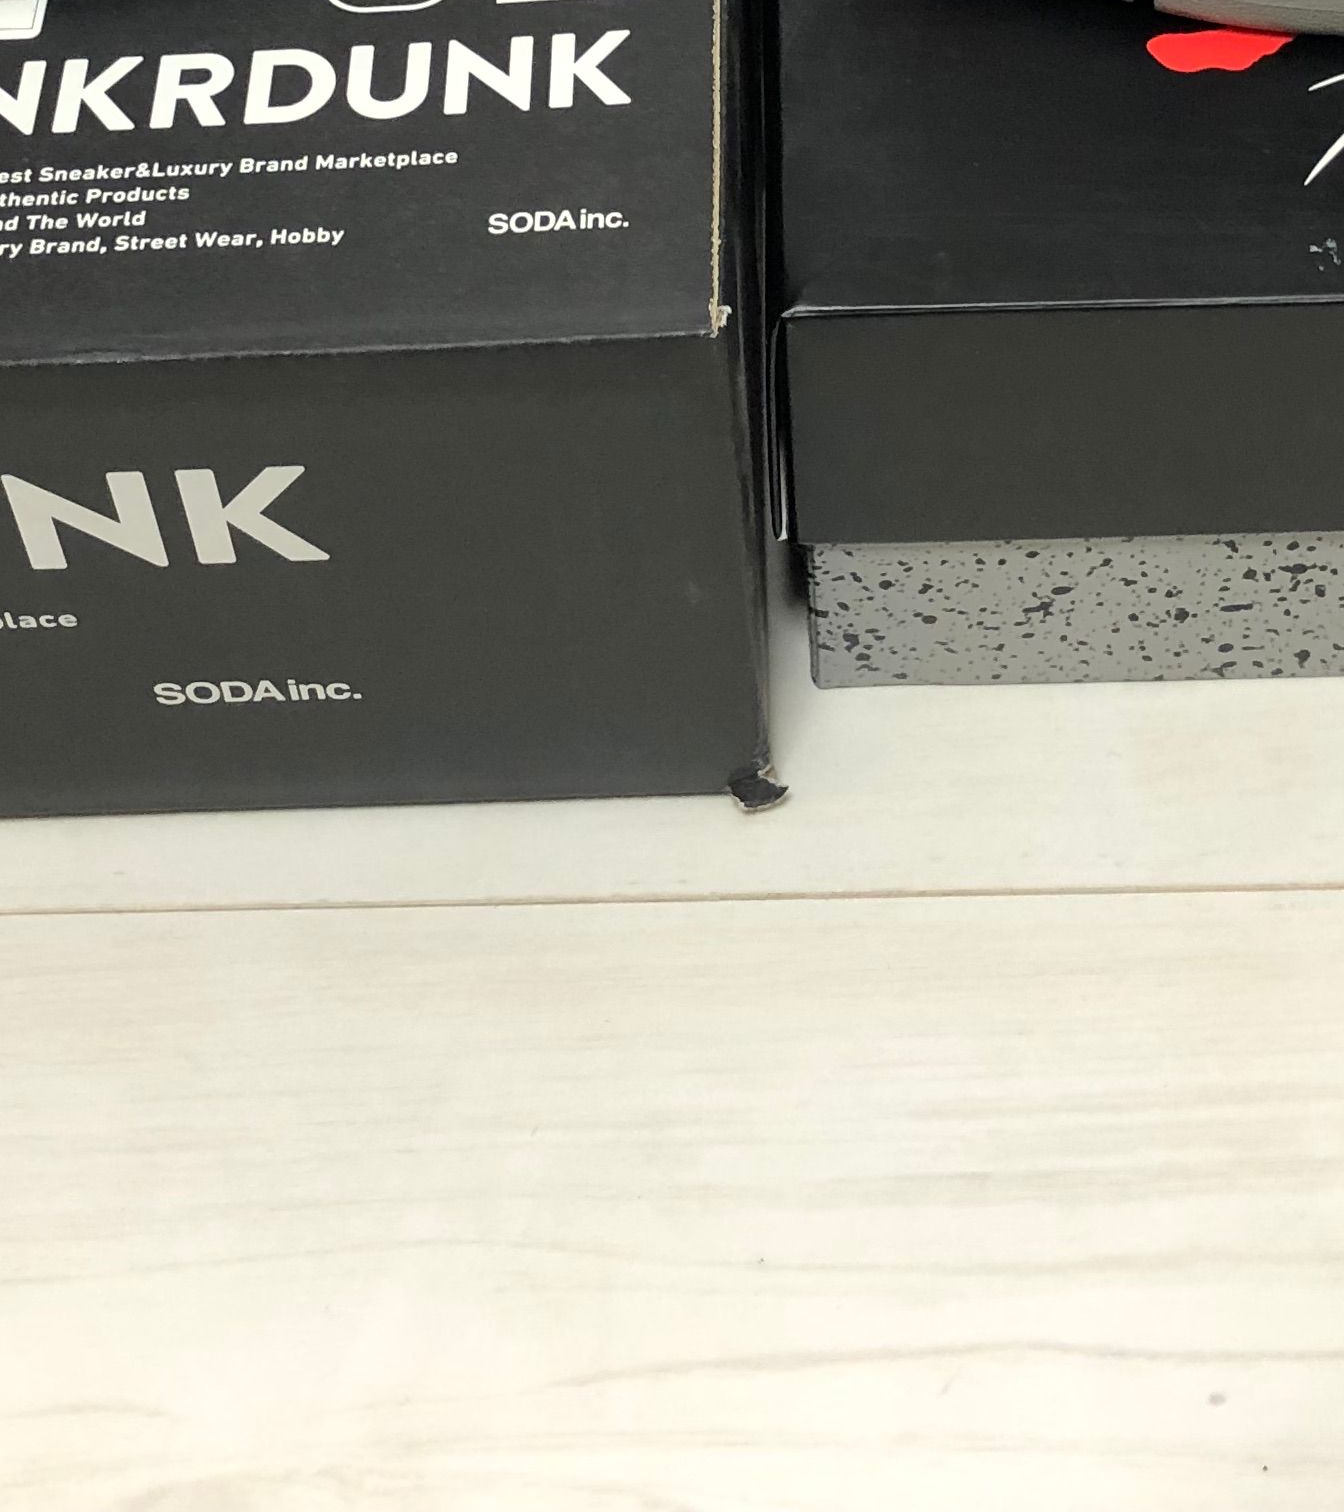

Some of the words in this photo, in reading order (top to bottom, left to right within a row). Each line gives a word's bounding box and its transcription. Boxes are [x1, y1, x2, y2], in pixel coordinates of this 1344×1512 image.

[38, 162, 234, 183] Sneaker&Luxury
[239, 155, 309, 174] Brand
[315, 150, 459, 171] Marketplace
[85, 186, 190, 204] Products
[26, 214, 69, 230] The
[76, 210, 147, 229] World
[29, 236, 108, 255] Brand,
[113, 233, 188, 252] Street
[194, 231, 264, 248] Wear,
[270, 226, 345, 246] Hobby
